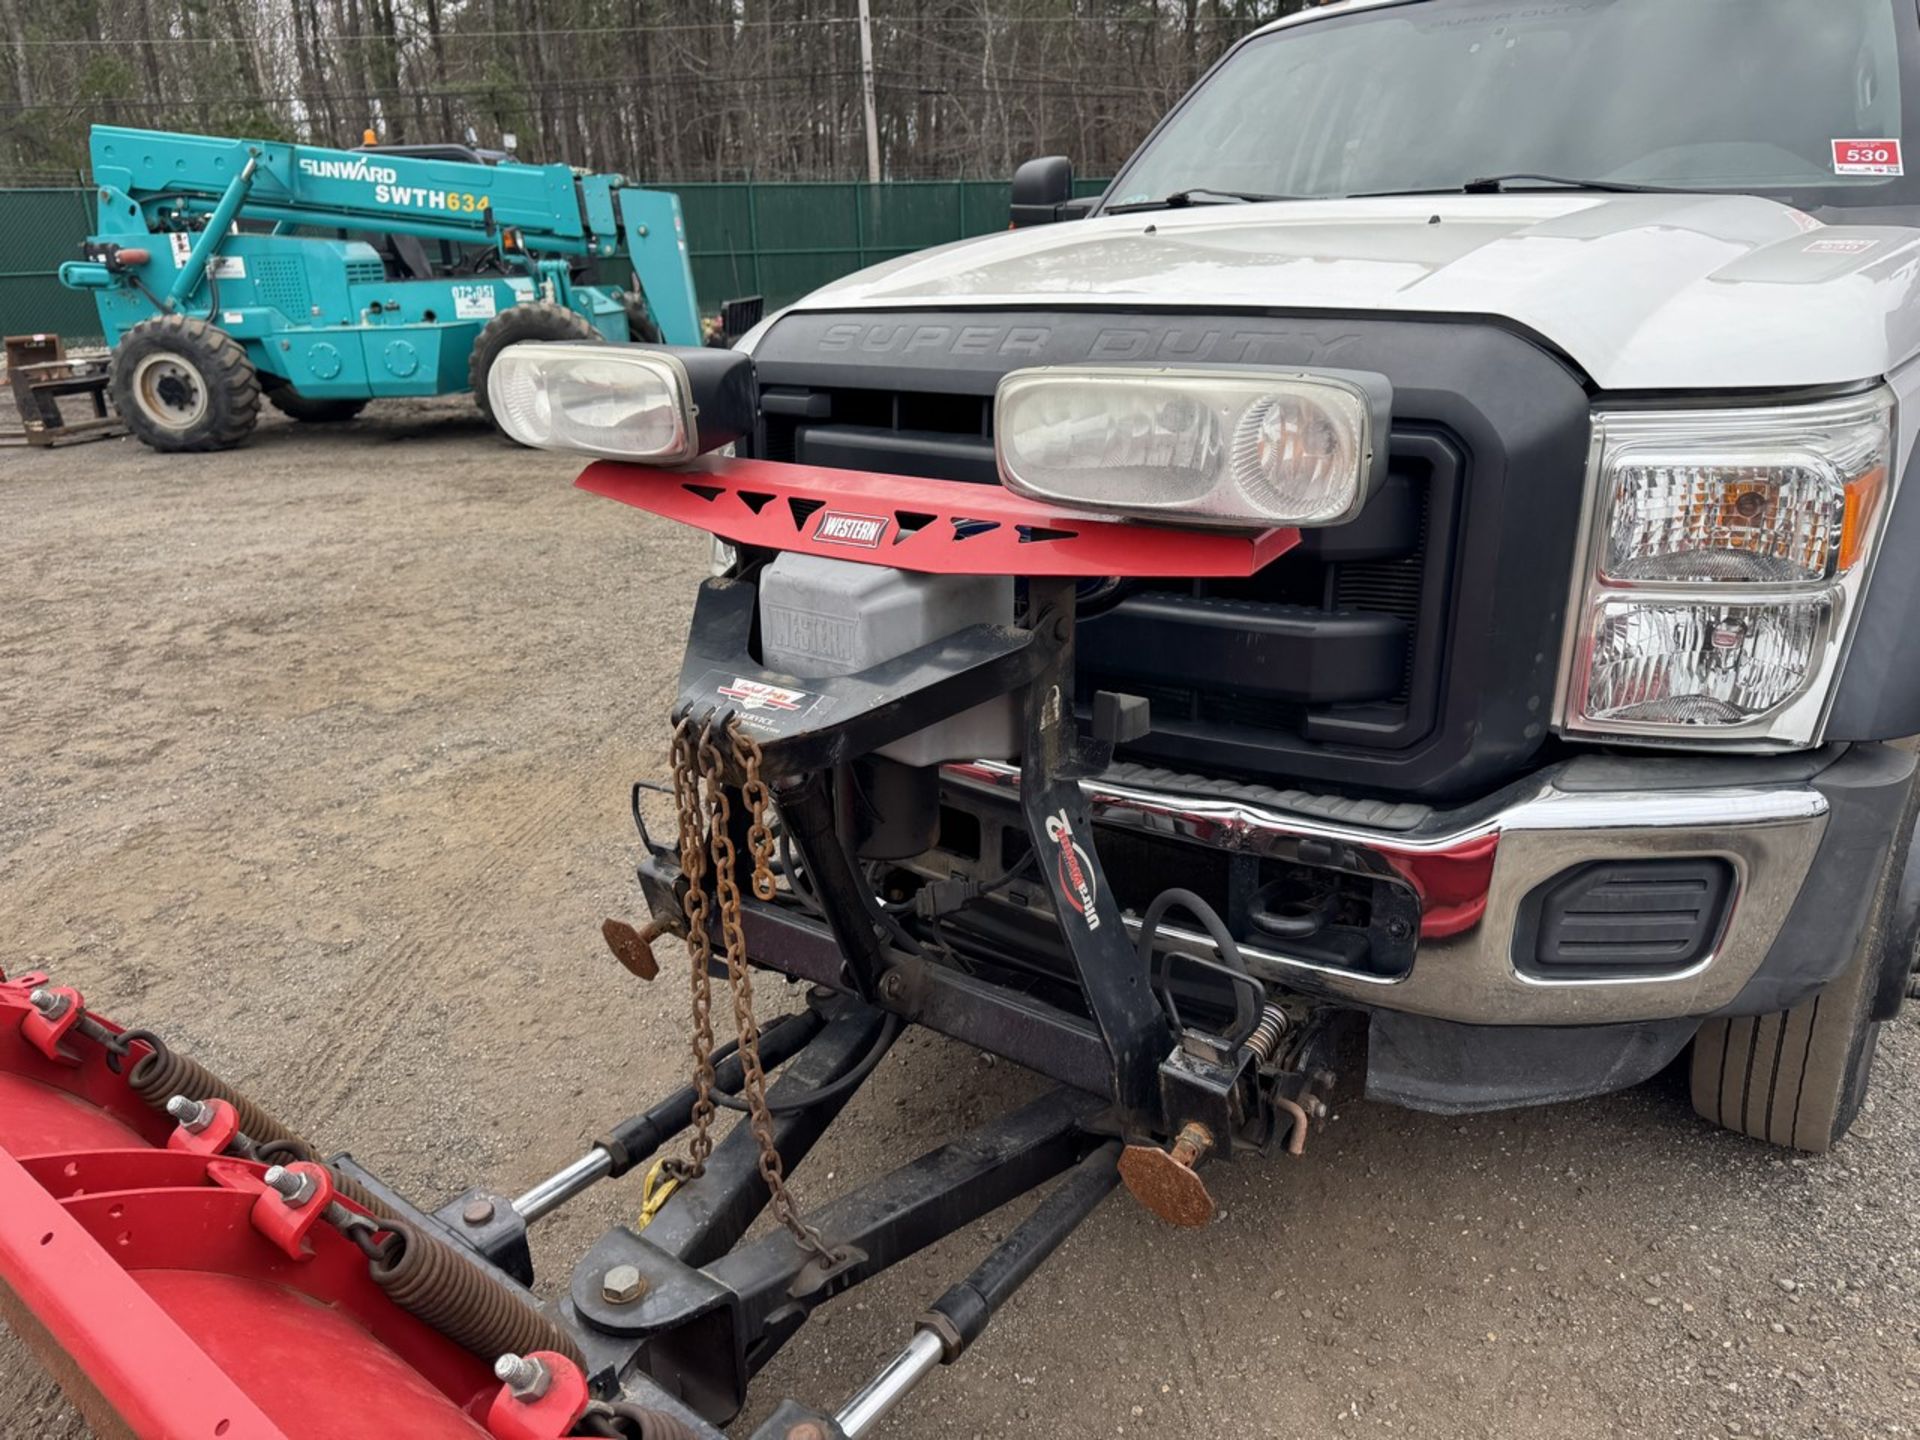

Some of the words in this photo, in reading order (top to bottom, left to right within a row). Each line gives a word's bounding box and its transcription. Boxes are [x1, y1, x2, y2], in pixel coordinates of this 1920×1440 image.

[1846, 149, 1889, 162] 530
[299, 156, 397, 184] SUNWARD
[818, 322, 1052, 357] SUPER
[1087, 327, 1364, 363] DUTY
[823, 516, 880, 541] WESTERN
[768, 607, 855, 660] WESTERN
